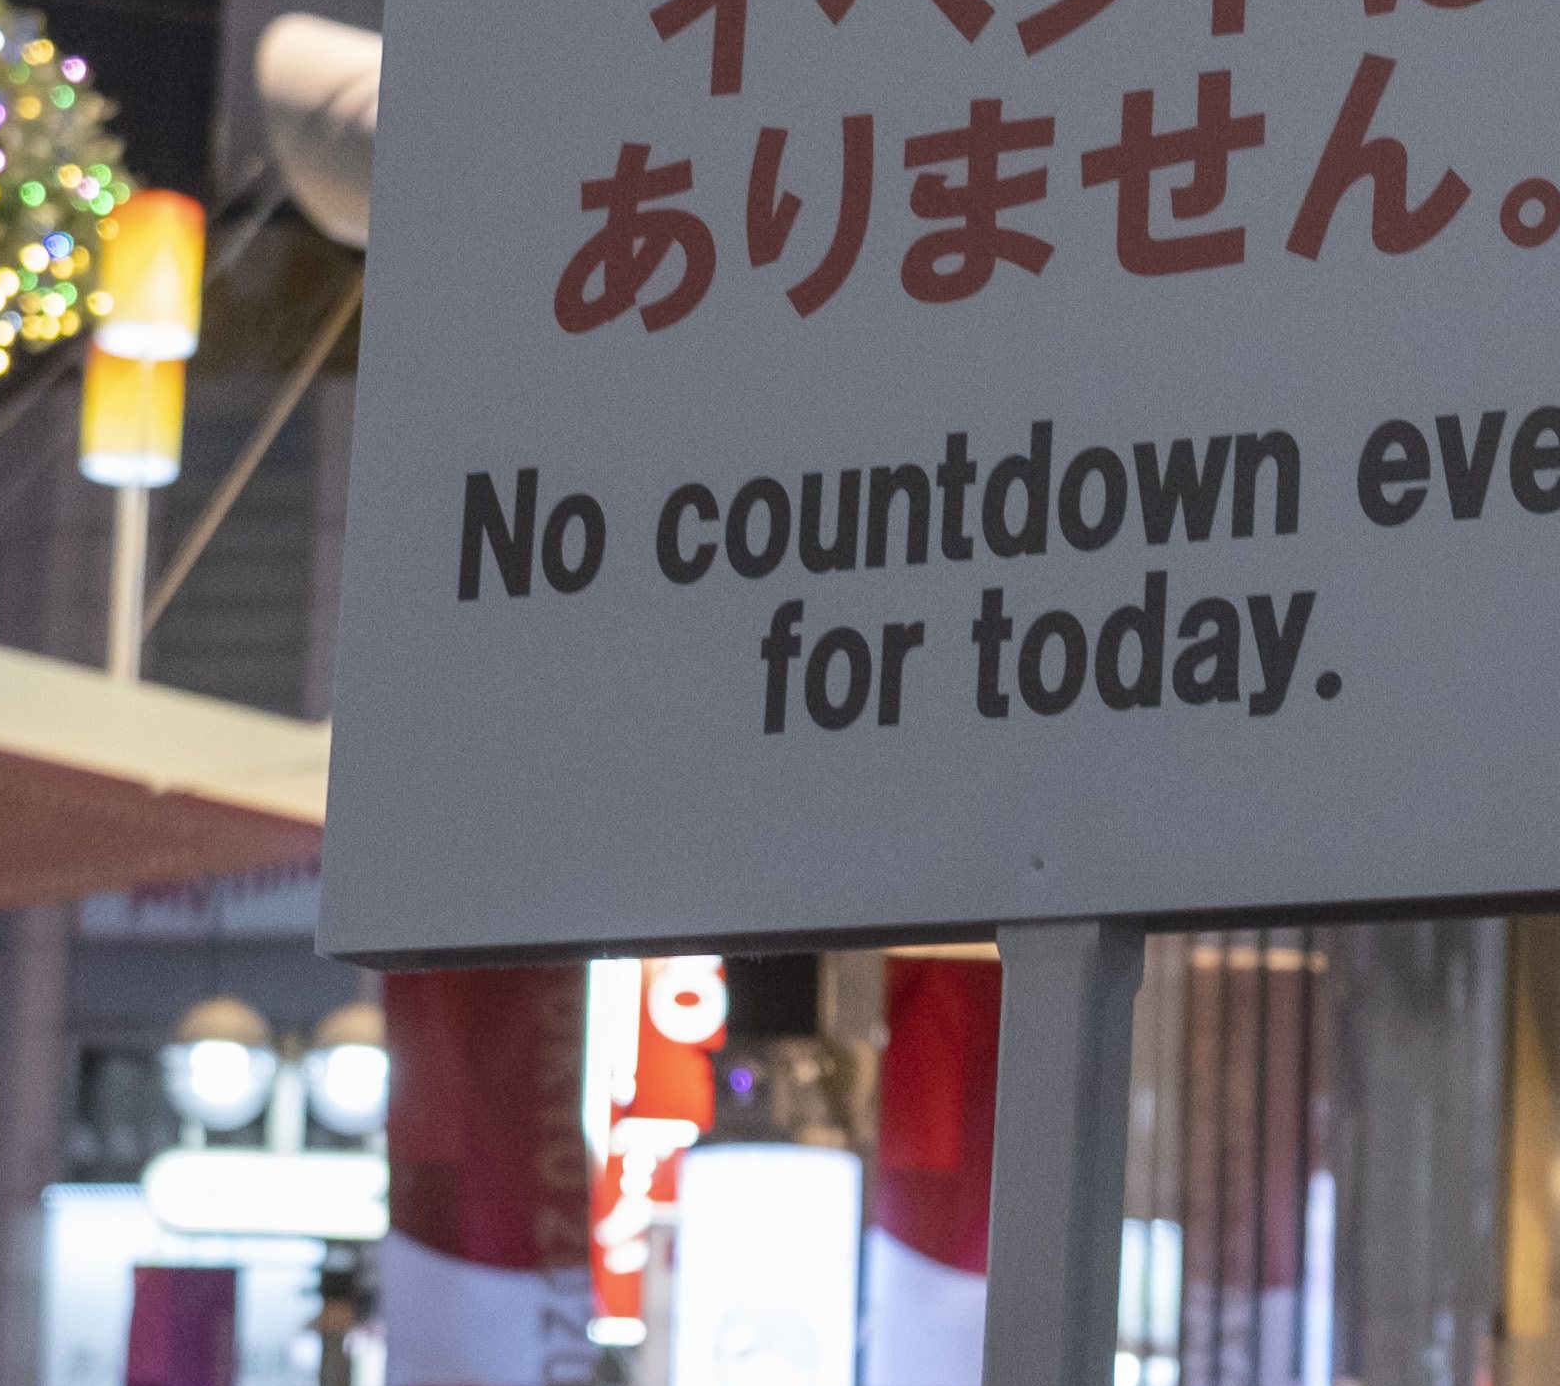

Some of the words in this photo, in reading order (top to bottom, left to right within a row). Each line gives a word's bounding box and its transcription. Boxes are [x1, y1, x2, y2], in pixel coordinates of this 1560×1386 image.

[456, 467, 607, 603] No
[654, 418, 1302, 586] countdown
[758, 598, 926, 736] for
[971, 569, 1345, 719] today.
